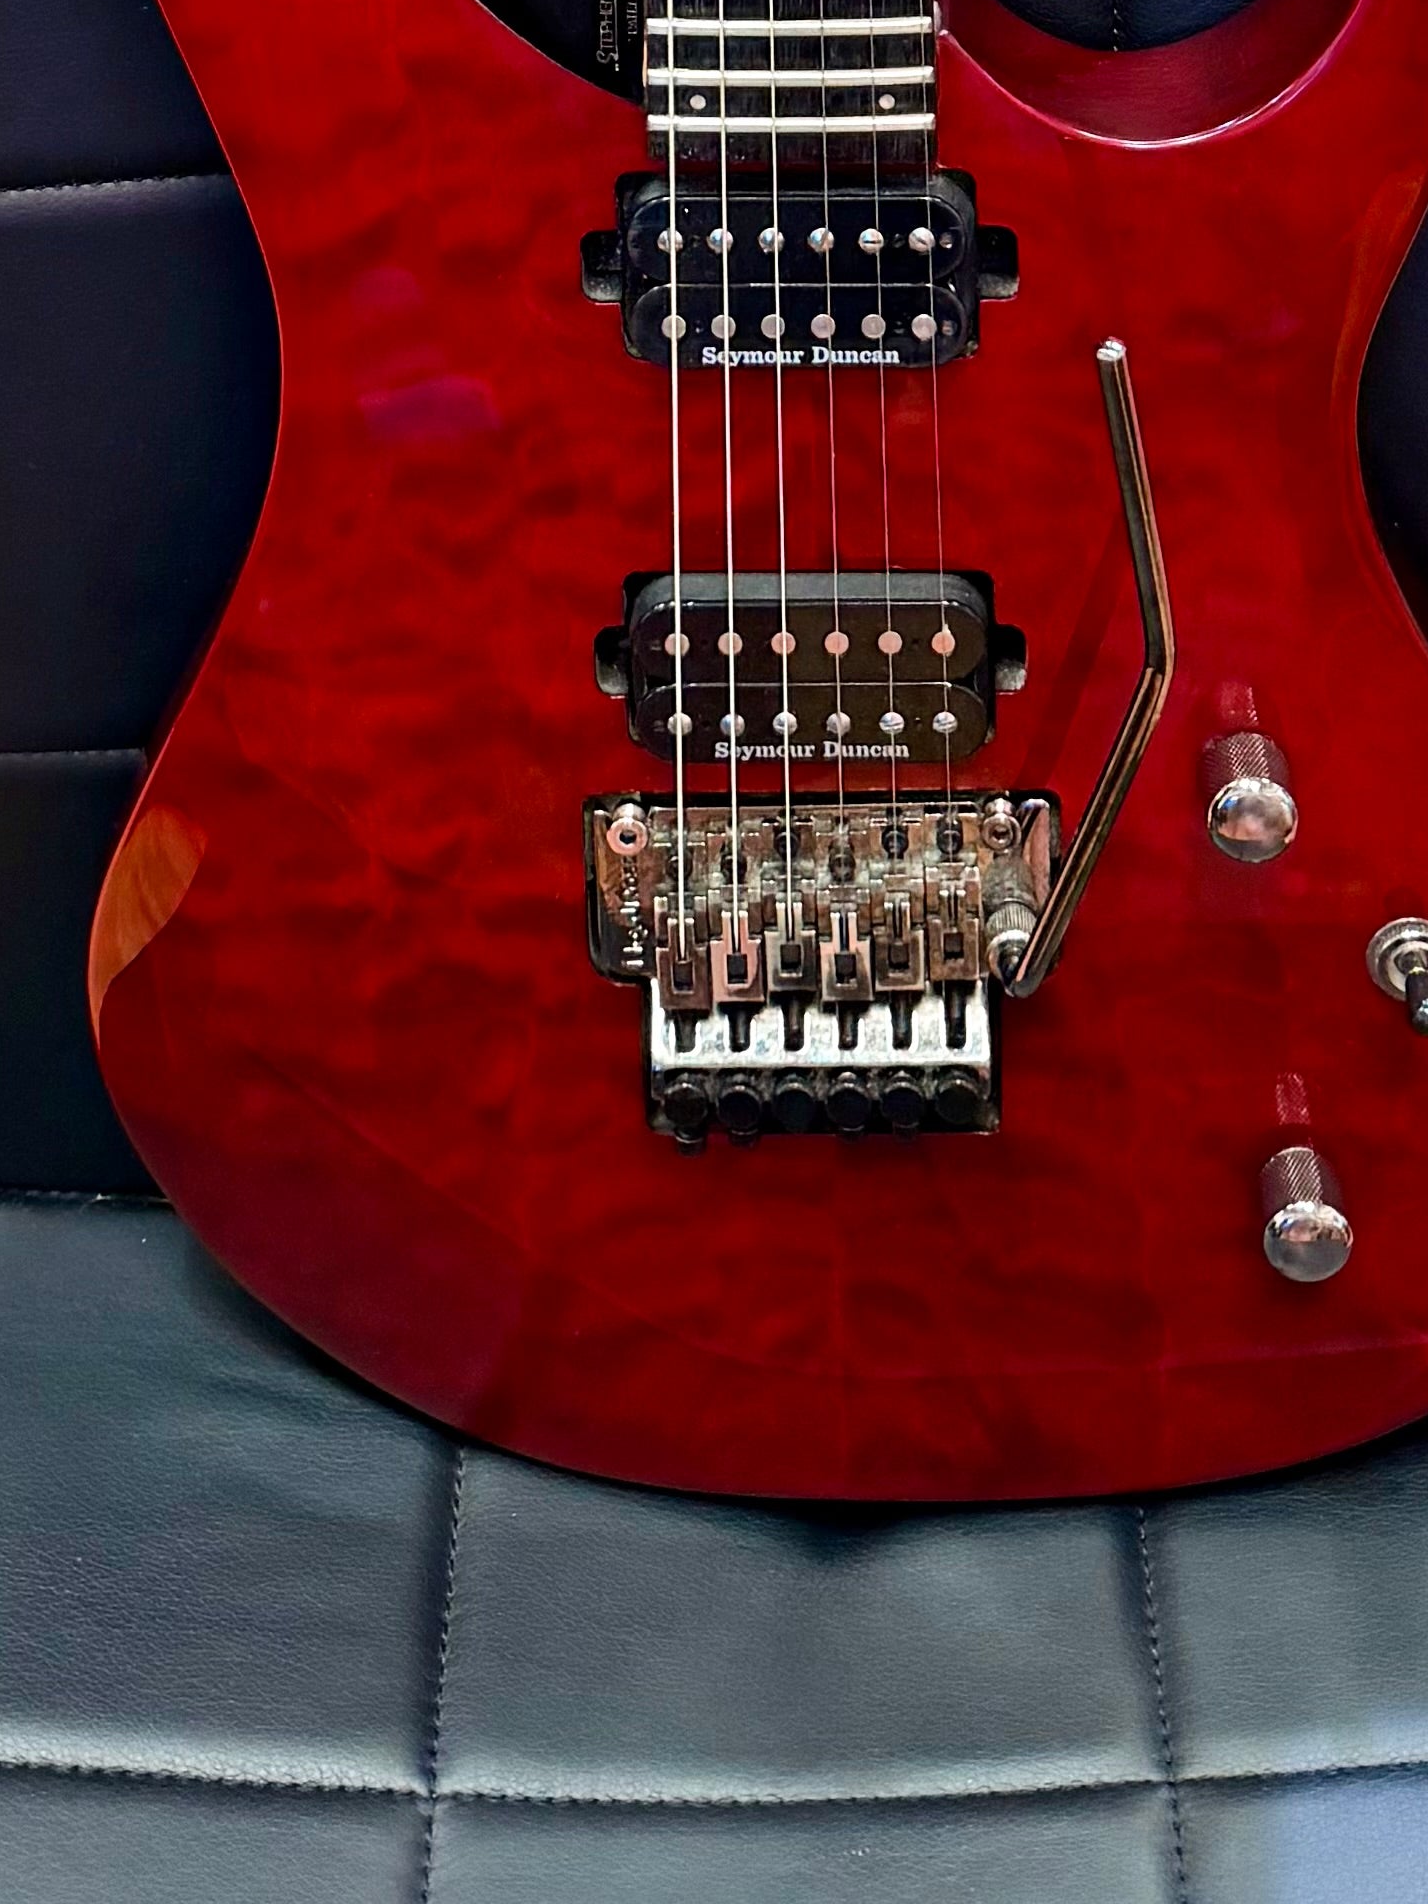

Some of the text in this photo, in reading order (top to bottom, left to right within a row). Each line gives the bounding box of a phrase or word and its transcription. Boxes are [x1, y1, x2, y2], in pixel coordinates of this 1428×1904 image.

[701, 345, 901, 370] Seymour Duncan
[713, 739, 911, 764] Seymour Duncan
